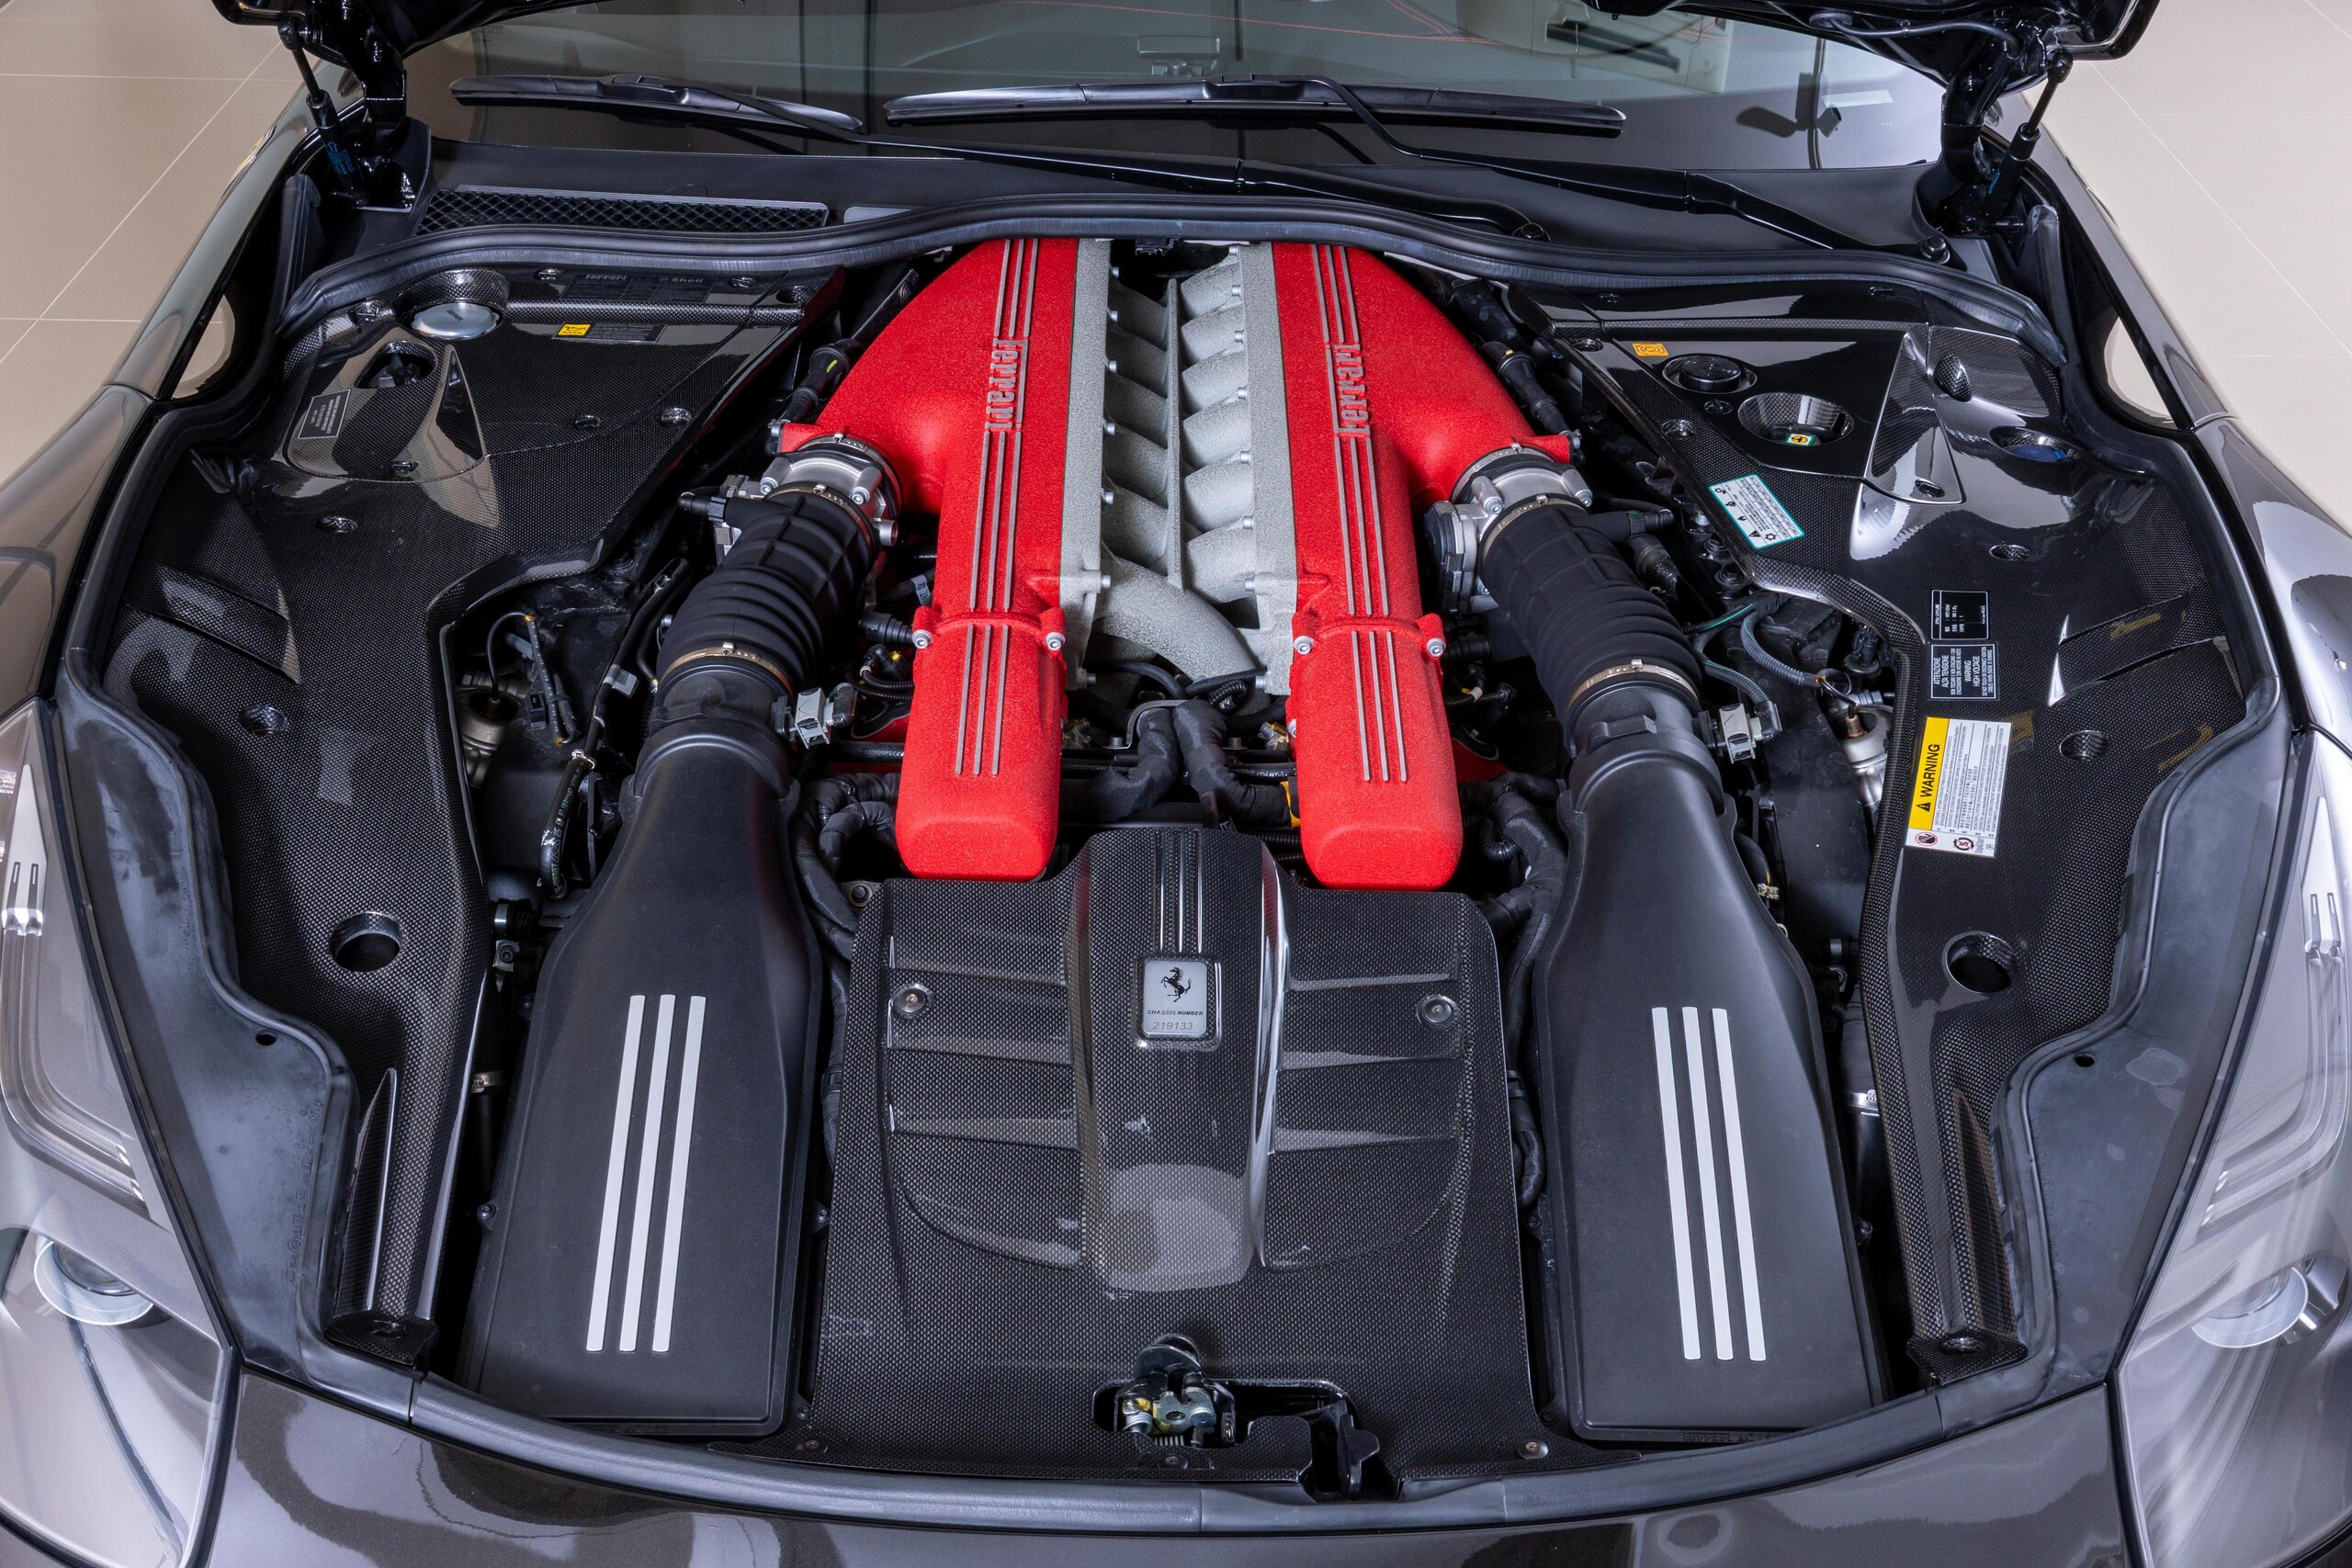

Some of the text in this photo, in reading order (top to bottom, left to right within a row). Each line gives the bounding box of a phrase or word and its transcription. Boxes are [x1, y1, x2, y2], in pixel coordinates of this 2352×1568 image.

[984, 338, 1029, 429] Ferrari
[1324, 344, 1371, 434] Ferrari
[1933, 657, 1941, 685] ATTENZIONE
[1963, 660, 1972, 682] WARNING
[1920, 743, 1940, 798] WARNING
[1152, 1021, 1193, 1031] 219133
